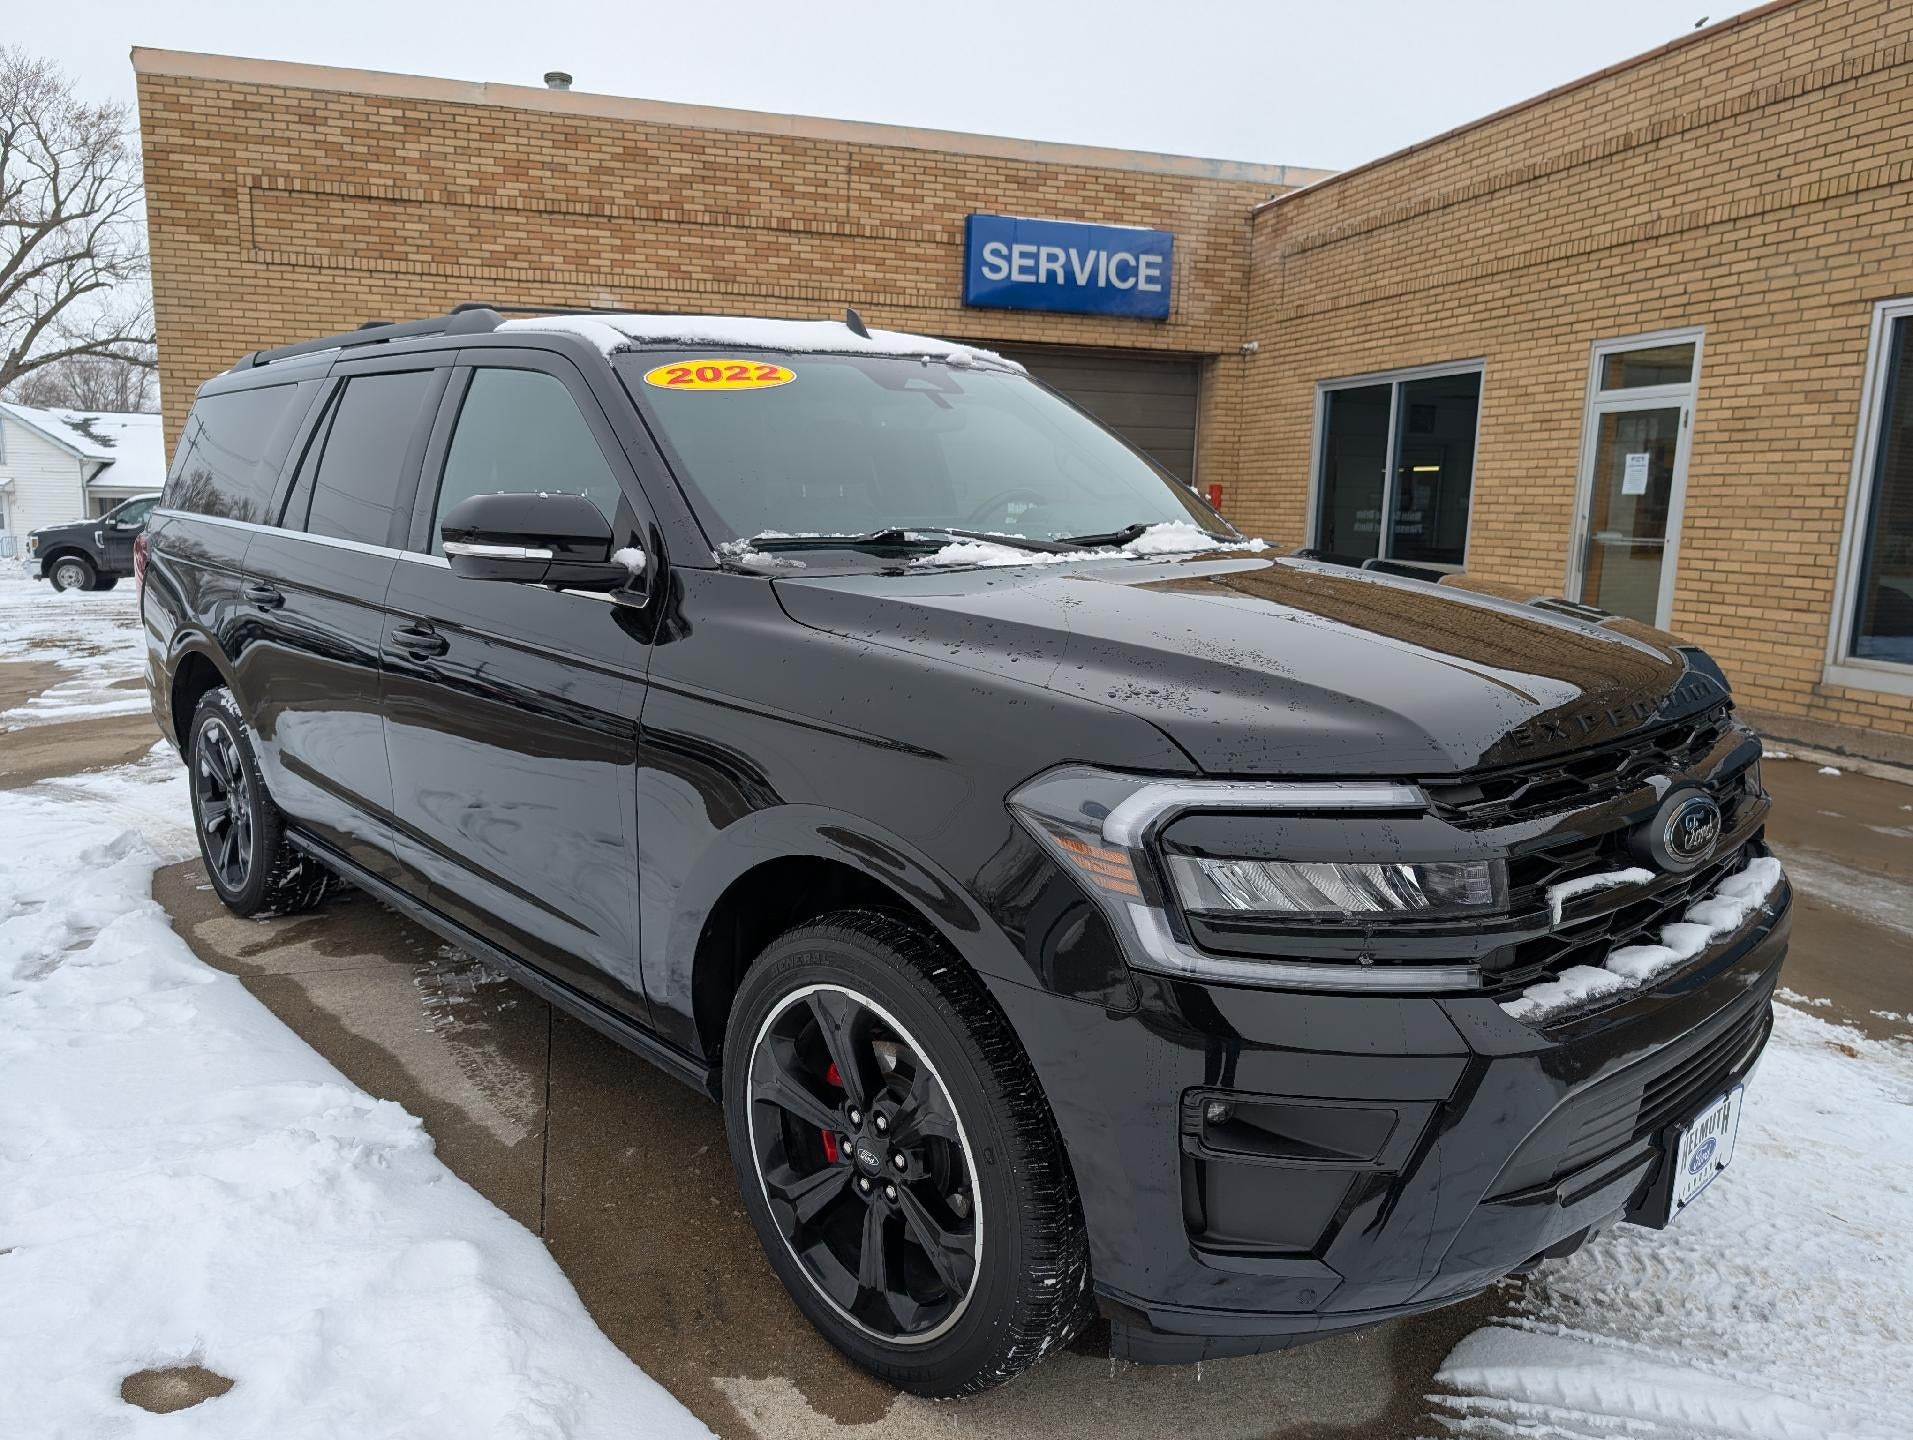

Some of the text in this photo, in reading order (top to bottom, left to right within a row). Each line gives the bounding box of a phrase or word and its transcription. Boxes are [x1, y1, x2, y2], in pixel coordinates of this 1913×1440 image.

[981, 241, 1163, 293] SERVICE
[666, 365, 783, 385] 2022
[1685, 809, 1714, 850] Ford
[1680, 1101, 1731, 1175] HELMUTH
